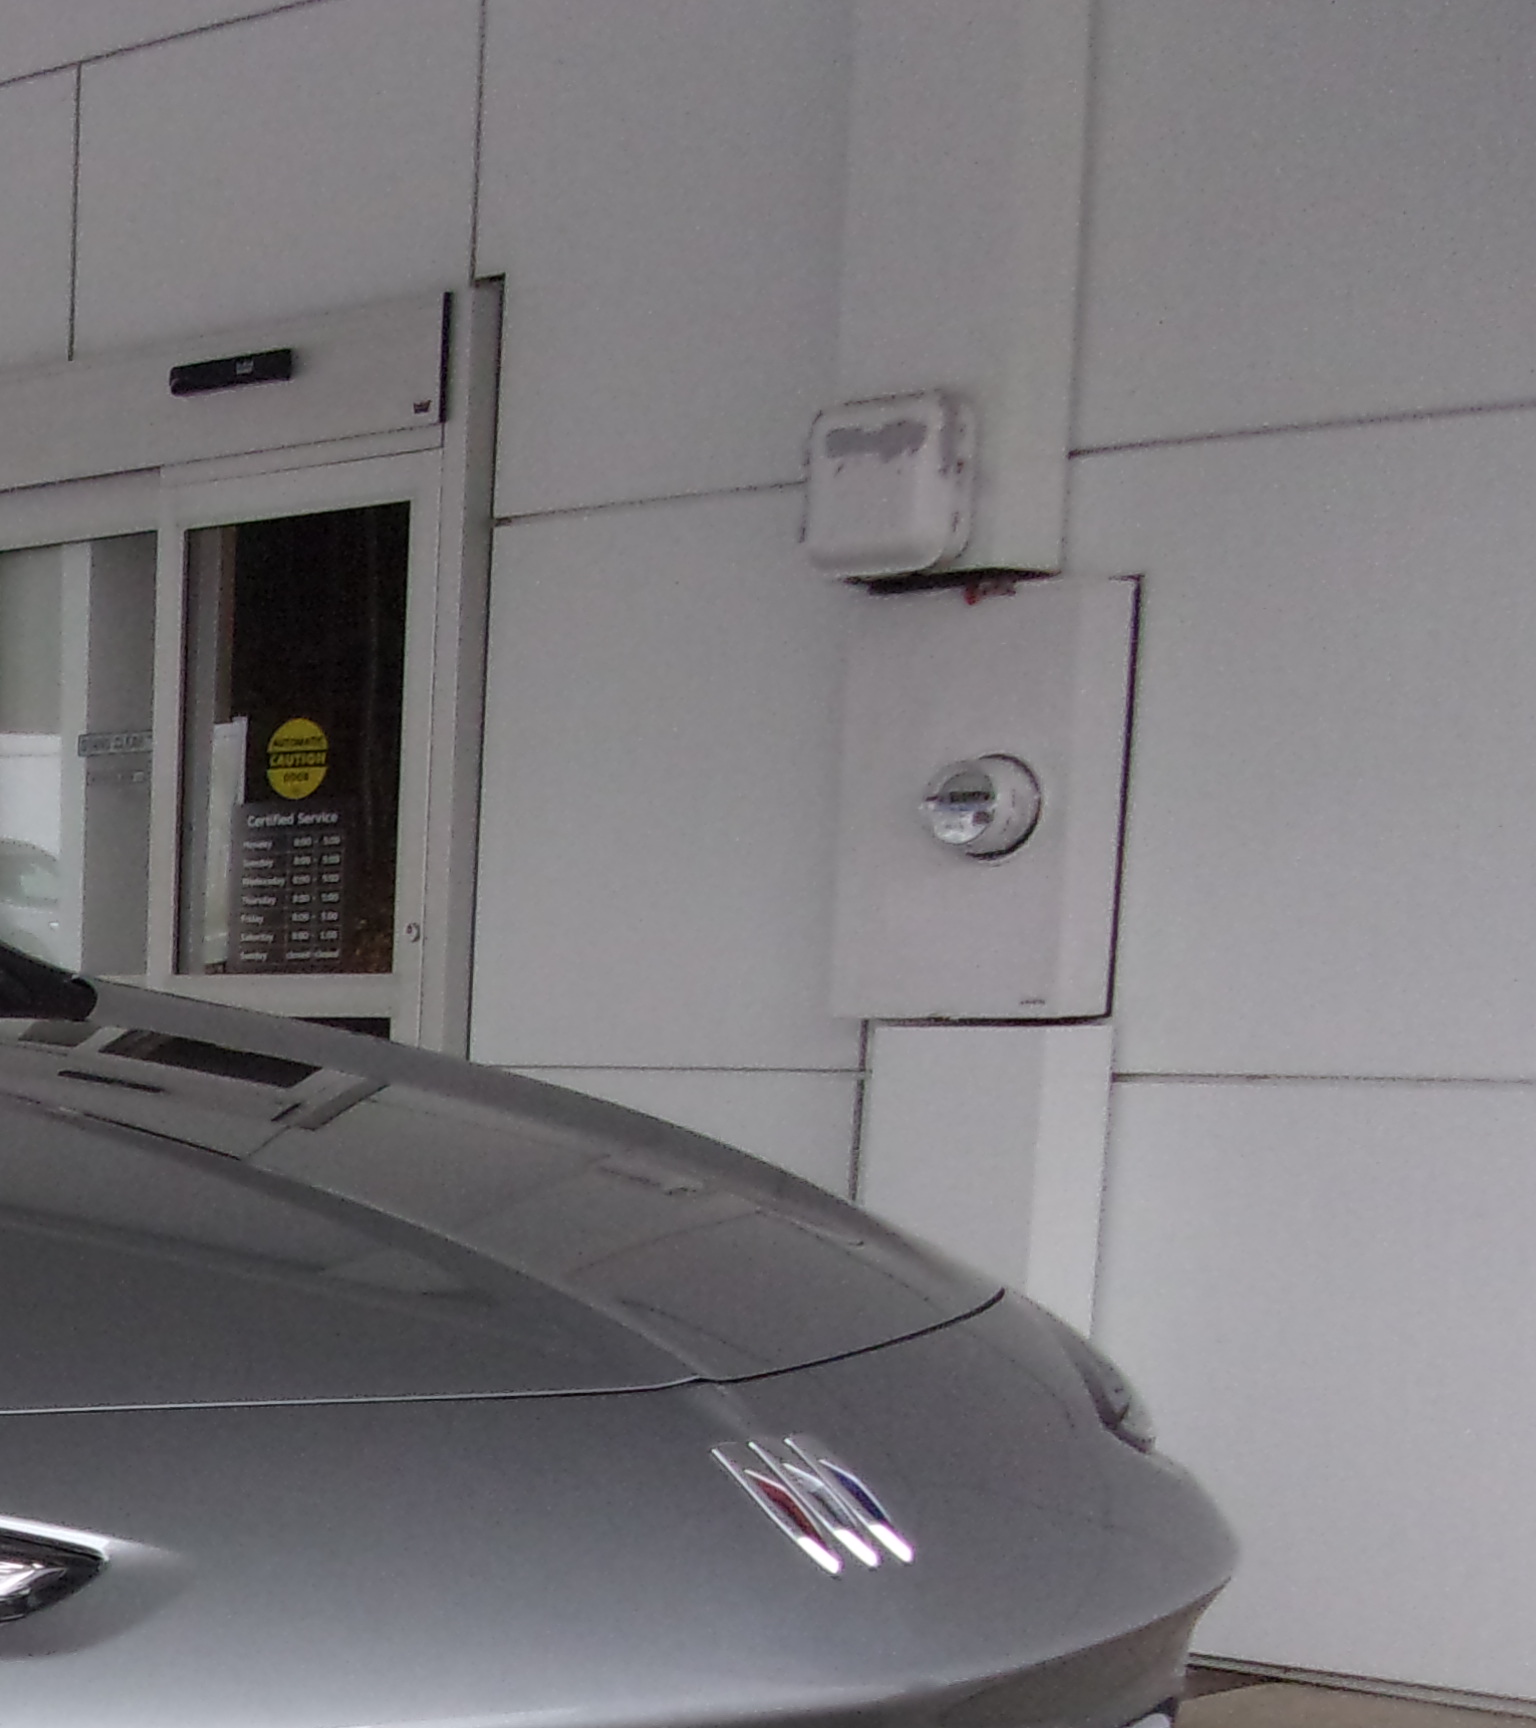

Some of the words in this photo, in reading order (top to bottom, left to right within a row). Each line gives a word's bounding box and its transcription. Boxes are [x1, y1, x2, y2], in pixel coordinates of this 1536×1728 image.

[269, 751, 327, 767] CAUTION
[247, 813, 295, 827] Certified
[297, 812, 339, 825] Service
[242, 877, 286, 887] Wednesday
